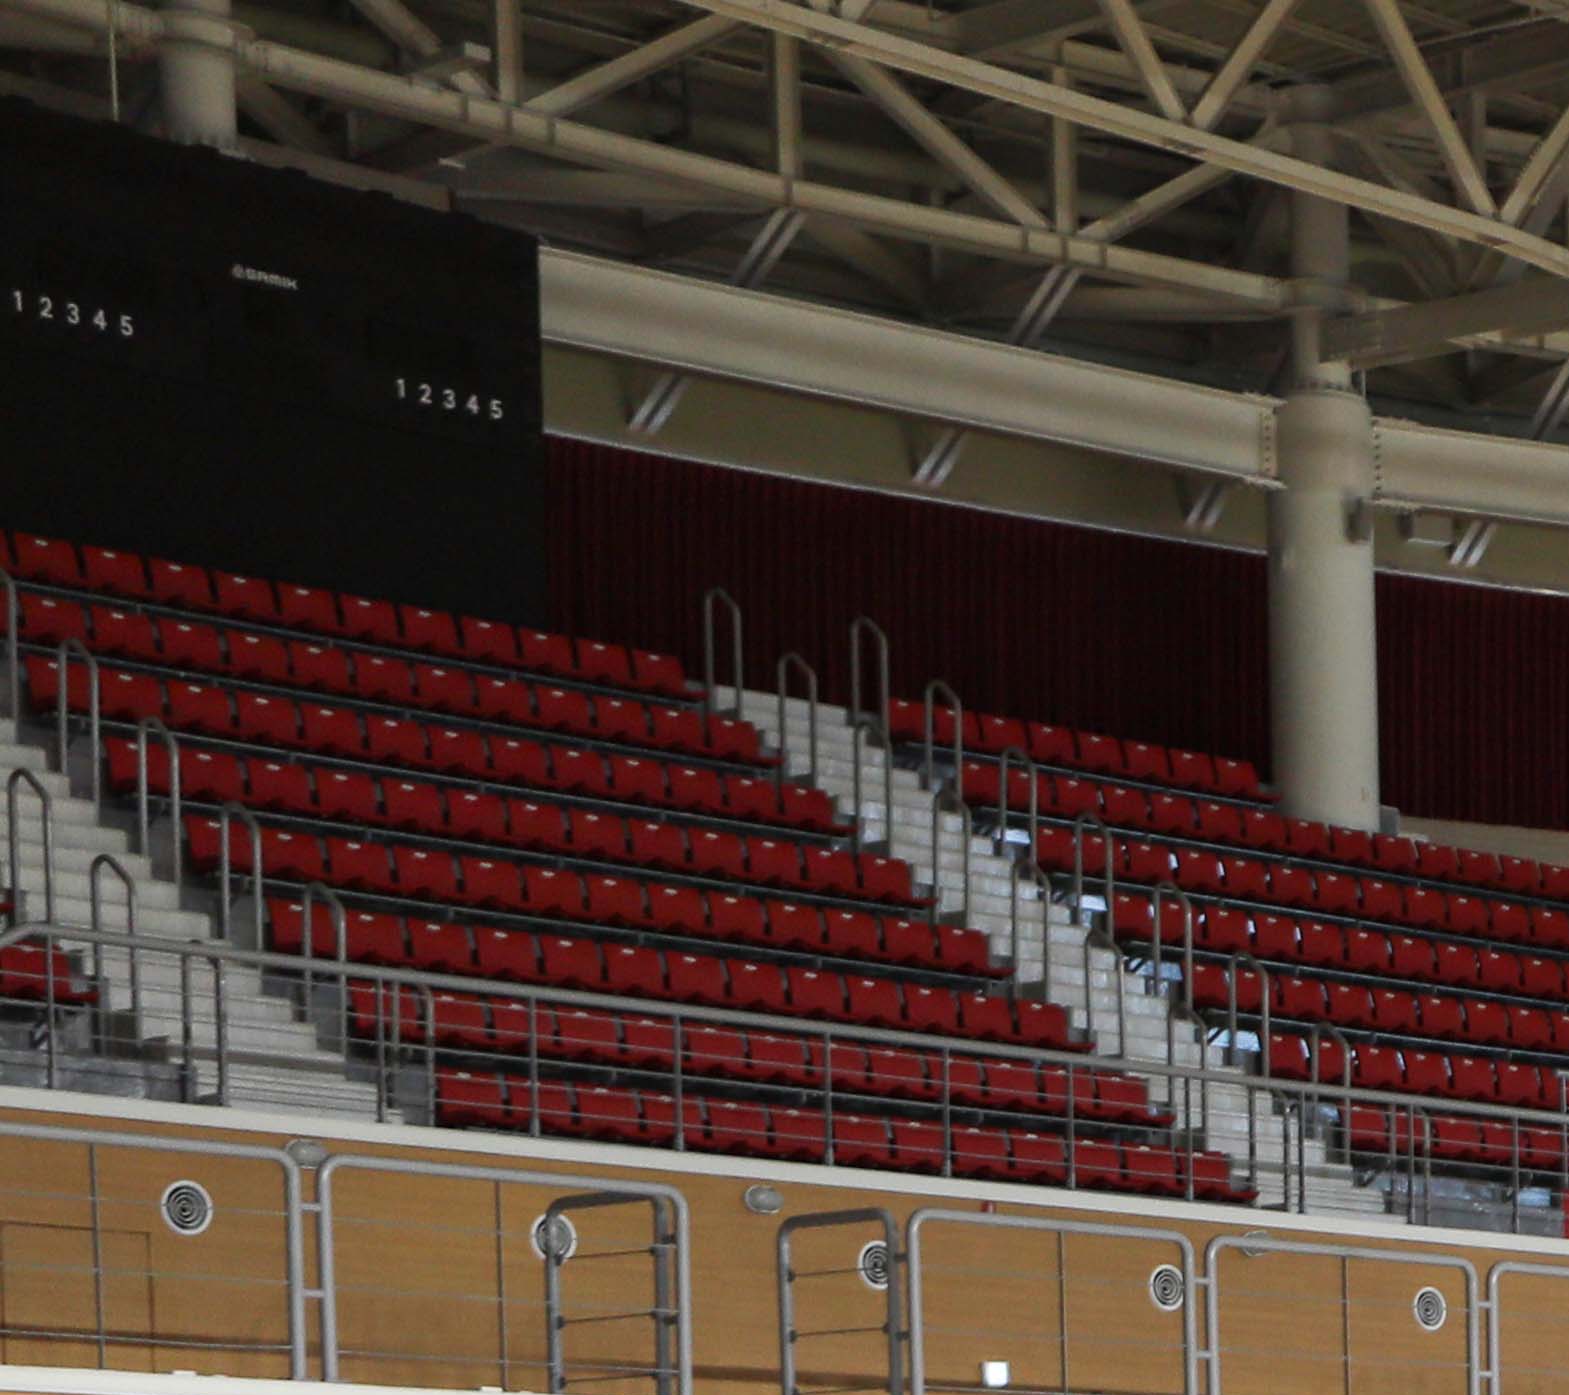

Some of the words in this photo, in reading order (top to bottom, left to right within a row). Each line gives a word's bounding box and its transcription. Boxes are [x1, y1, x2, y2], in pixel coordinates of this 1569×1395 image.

[13, 290, 23, 311] 1
[40, 296, 53, 318] 2
[66, 303, 80, 324] 3
[93, 309, 107, 330] 4
[120, 314, 134, 336] 5
[396, 378, 406, 399] 1
[419, 383, 432, 404] 2
[442, 388, 456, 409] 3
[466, 394, 480, 414] 4
[489, 399, 503, 419] 5
